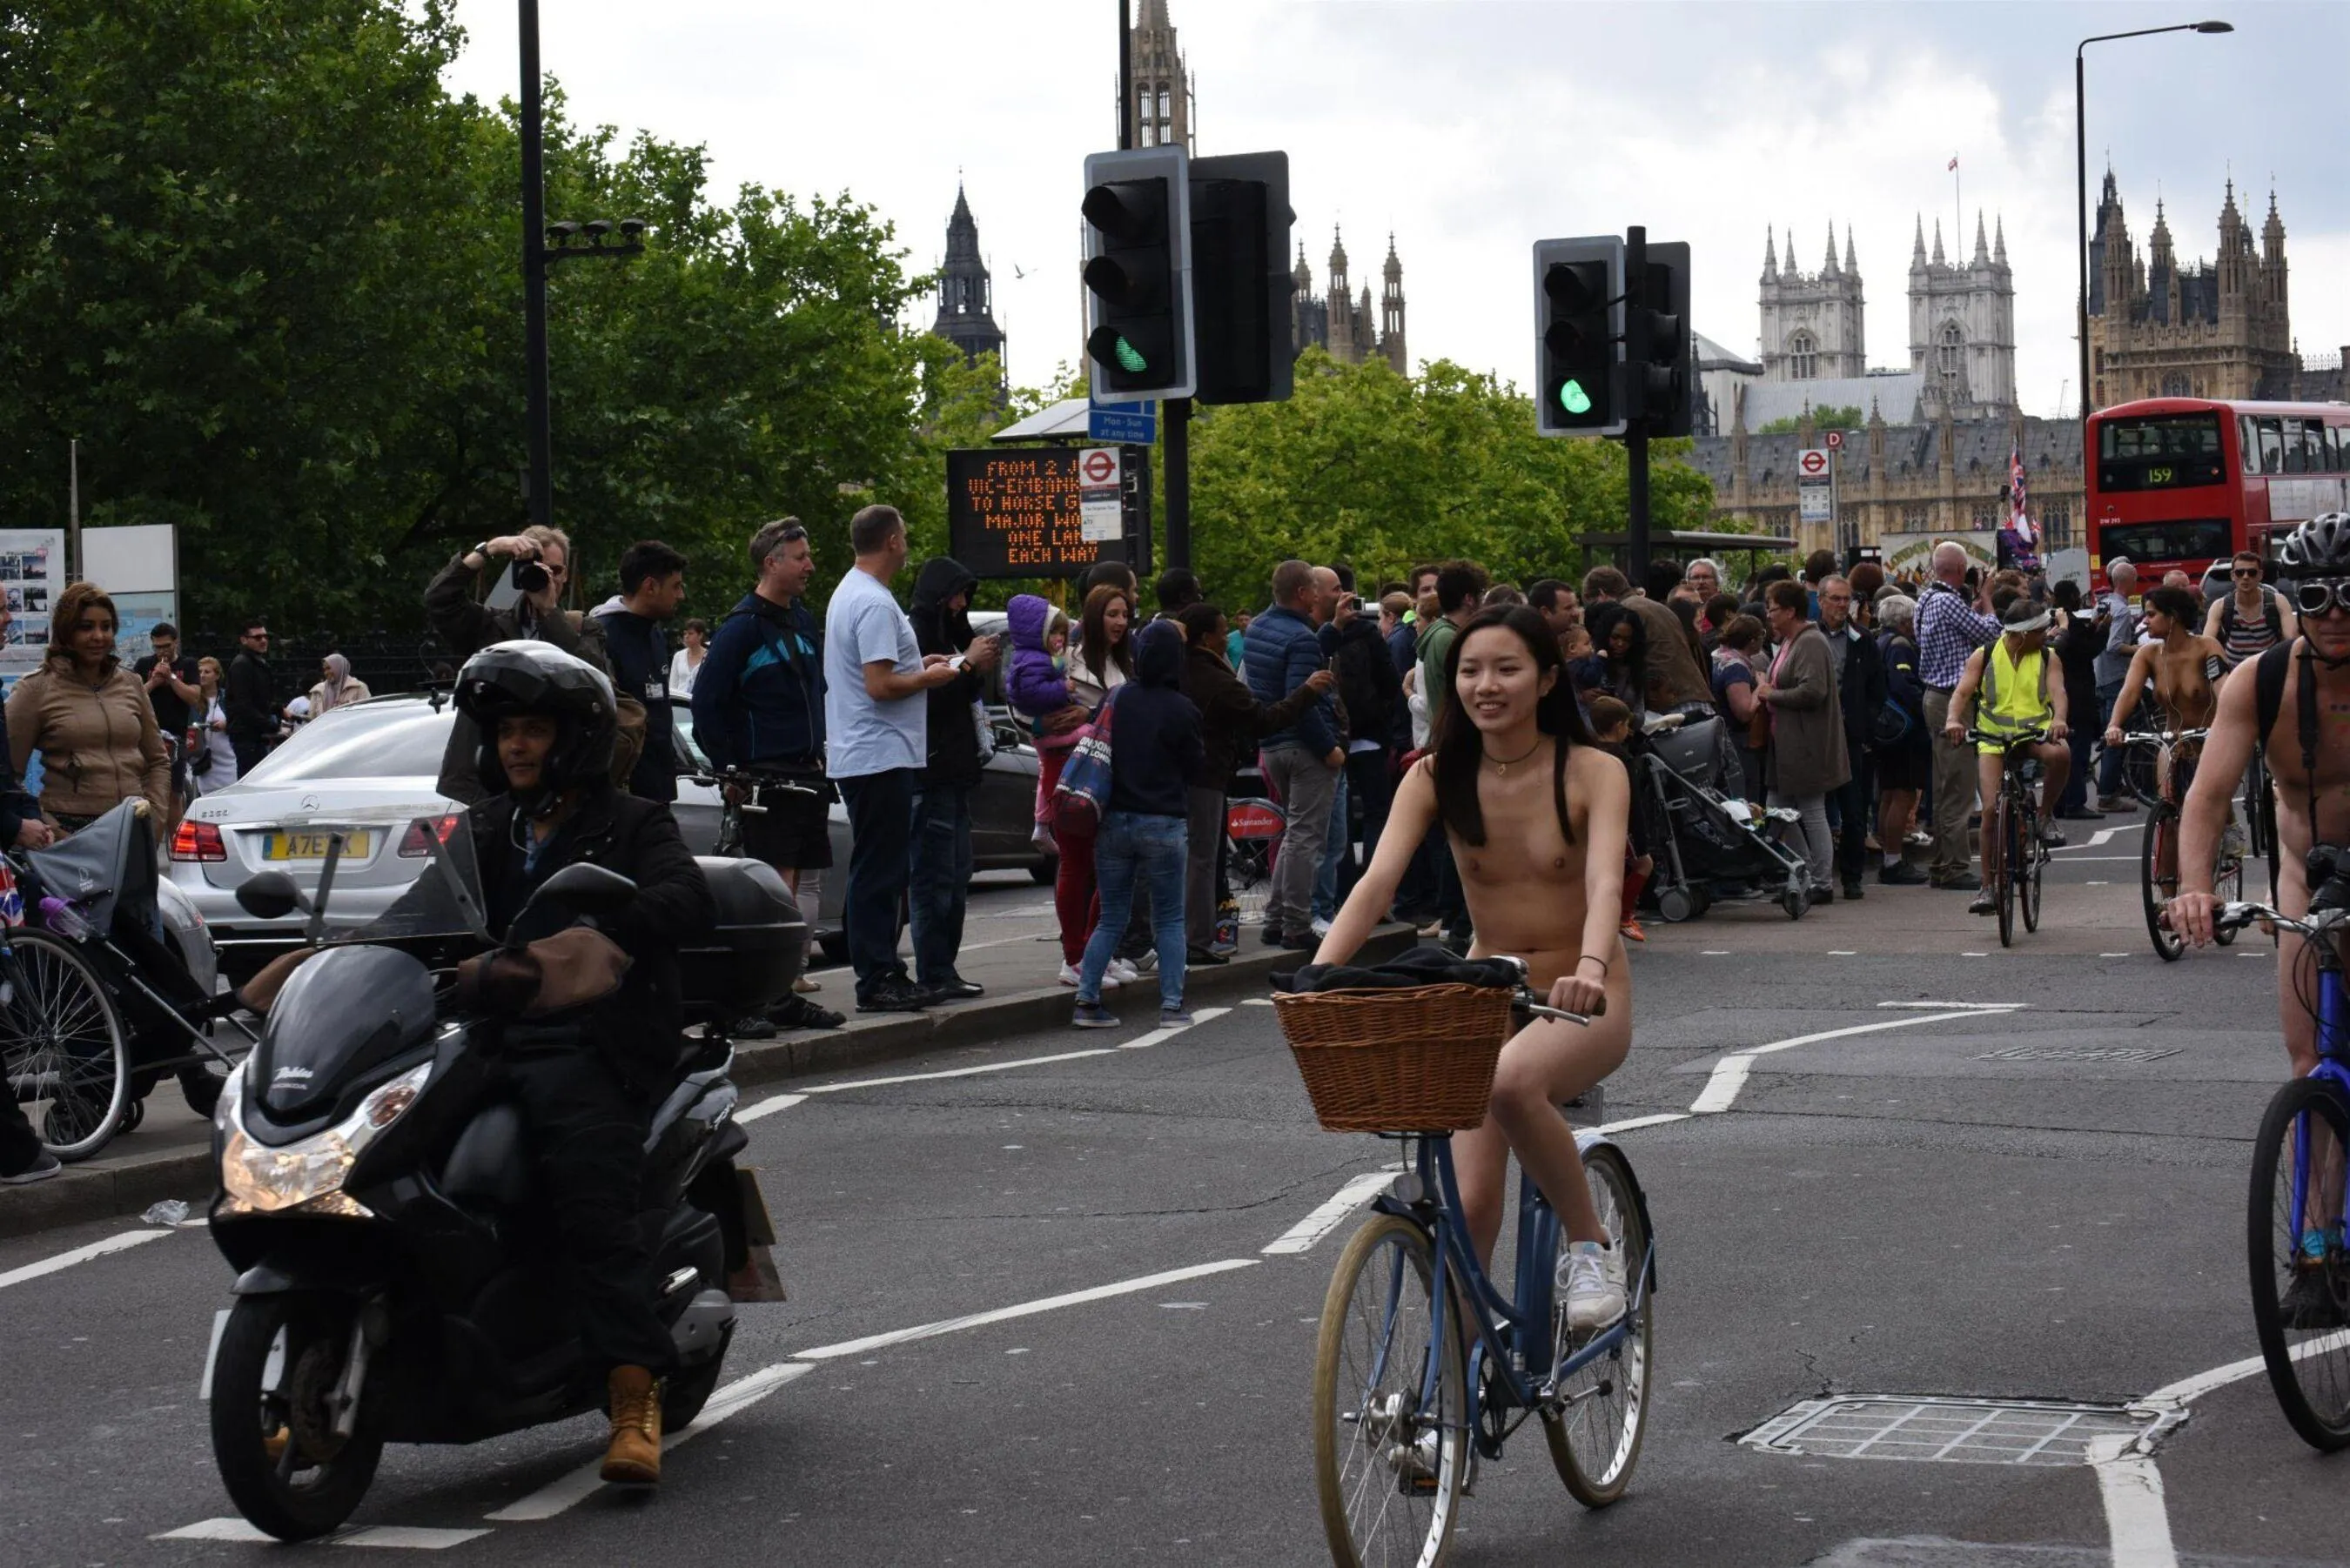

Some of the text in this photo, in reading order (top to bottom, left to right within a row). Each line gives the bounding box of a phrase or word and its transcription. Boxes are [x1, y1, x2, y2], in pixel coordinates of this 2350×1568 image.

[1829, 433, 1840, 445] D
[986, 460, 1036, 476] FROM
[1045, 459, 1058, 475] 2
[2149, 468, 2172, 483] 159
[972, 496, 993, 512] TO
[1002, 495, 1056, 511] HORSE
[985, 513, 1044, 529] MAJOR
[1009, 530, 1043, 546] ONE
[1051, 529, 1097, 545] LAN
[1008, 546, 1098, 563] EACH WAY
[1239, 816, 1273, 827] Santander
[285, 834, 352, 855] A7EX
